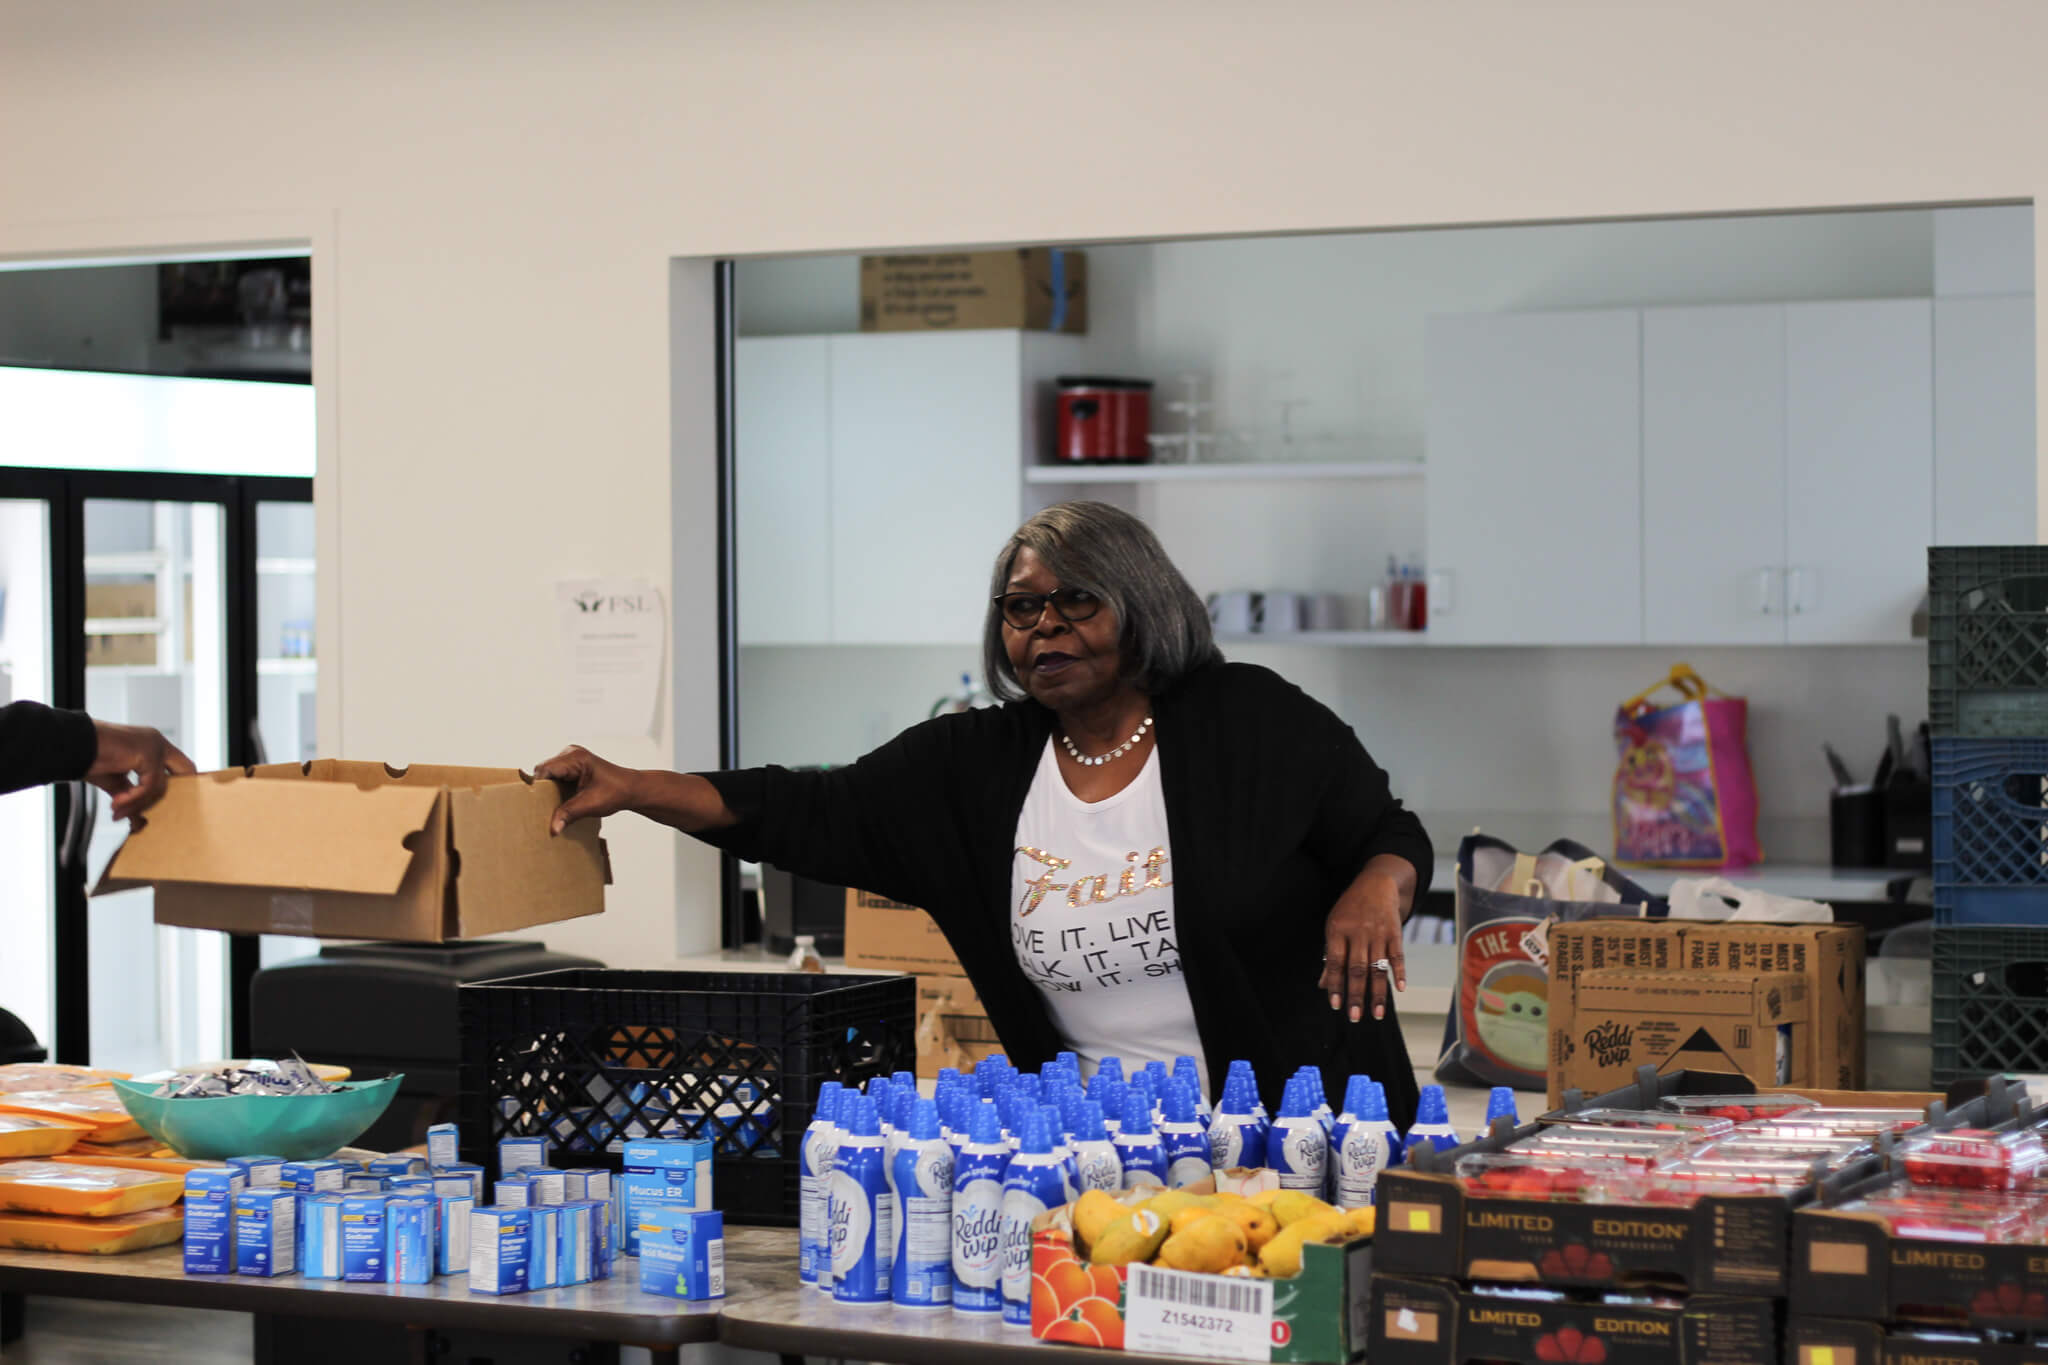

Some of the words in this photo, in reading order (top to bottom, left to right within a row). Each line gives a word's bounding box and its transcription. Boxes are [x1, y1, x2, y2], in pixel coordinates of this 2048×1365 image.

[1061, 927, 1095, 951] IT.
[1109, 910, 1171, 941] LIVE
[1083, 950, 1119, 973] IT.
[1131, 937, 1179, 960] TA
[1475, 931, 1511, 958] THE
[1572, 936, 1584, 960] THIS
[1708, 941, 1720, 966] THIS
[1557, 934, 1568, 981] FRAGILE
[1096, 971, 1132, 987] IT.
[1584, 1024, 1634, 1059] Reddi
[1598, 1047, 1631, 1067] wip
[629, 1186, 664, 1197] Mucus
[666, 1187, 682, 1197] ER
[955, 1210, 1002, 1248] Reddi
[1467, 1212, 1553, 1232] LIMITED
[1592, 1219, 1685, 1239] EDITION
[963, 1236, 998, 1258] wip
[1892, 1250, 1985, 1269] LIMITED
[1161, 1309, 1233, 1333] Z1542372
[1469, 1309, 1542, 1327] LIMITED
[1594, 1318, 1671, 1335] EDITION
